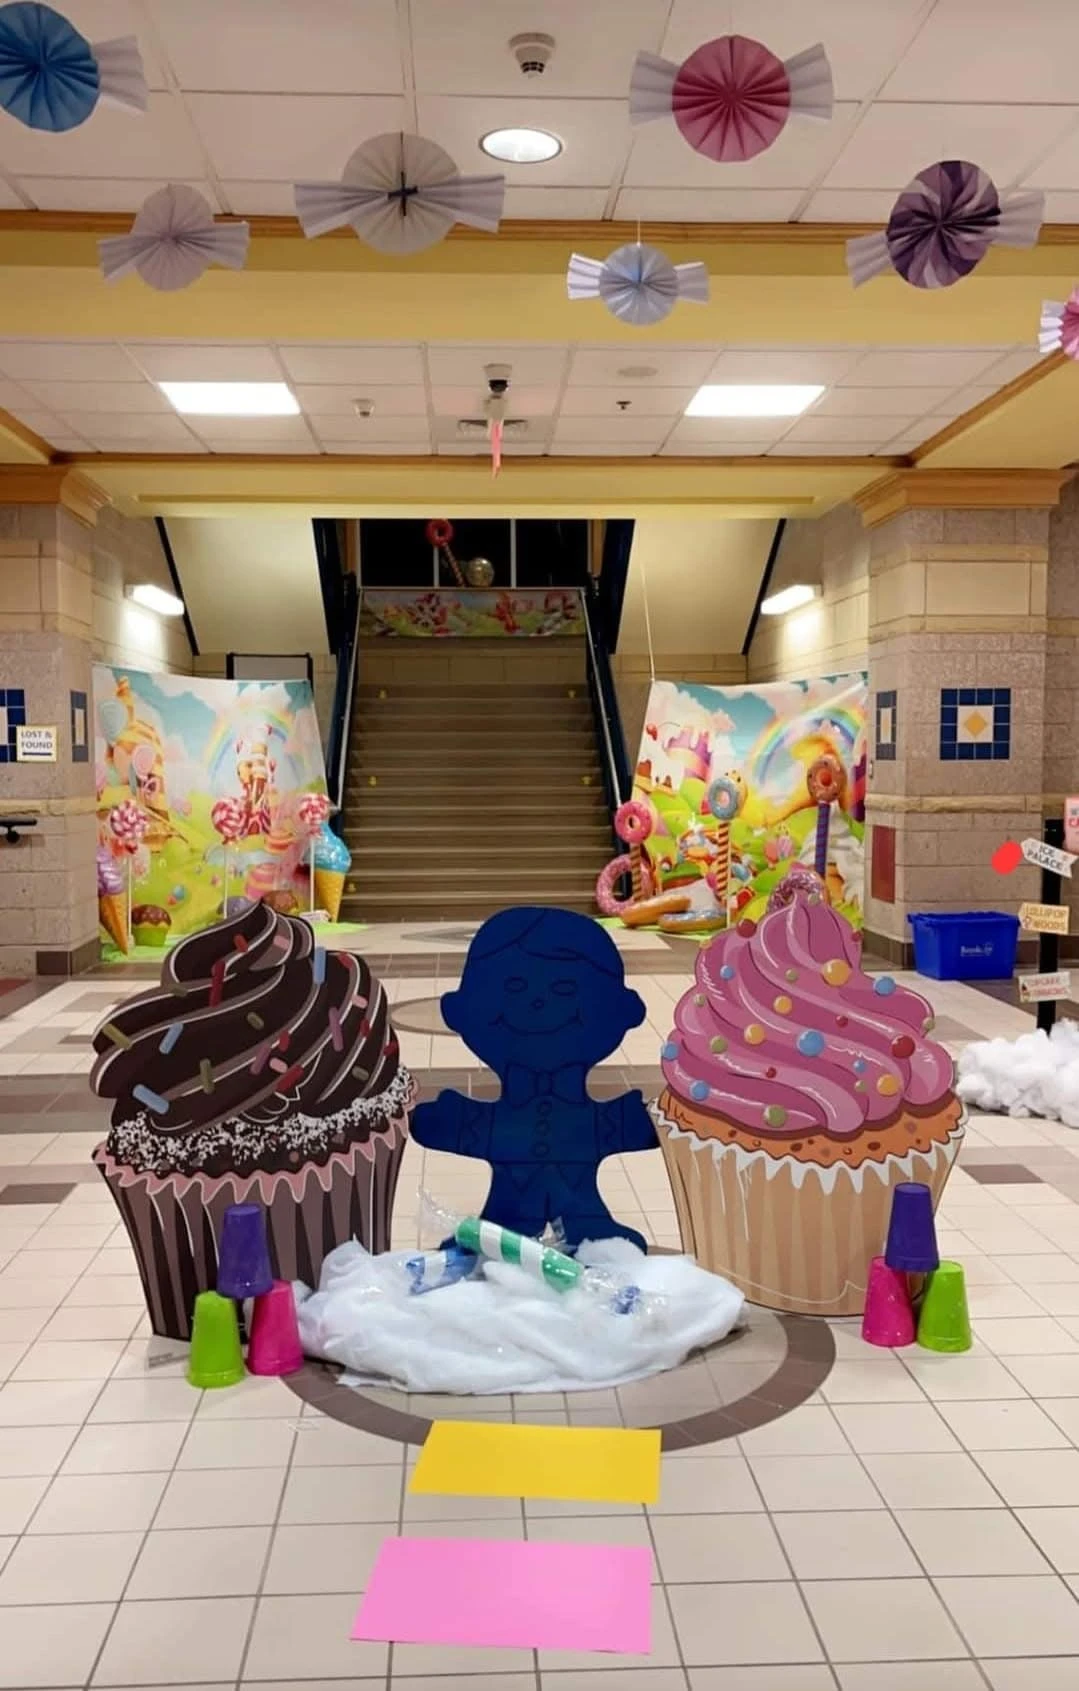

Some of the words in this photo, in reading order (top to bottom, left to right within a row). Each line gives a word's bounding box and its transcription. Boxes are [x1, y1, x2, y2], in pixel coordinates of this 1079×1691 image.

[1039, 845, 1056, 857] ICE
[1026, 848, 1064, 871] PALACE
[1025, 905, 1067, 919] LOLLIPOP
[1033, 919, 1066, 930] WOODS
